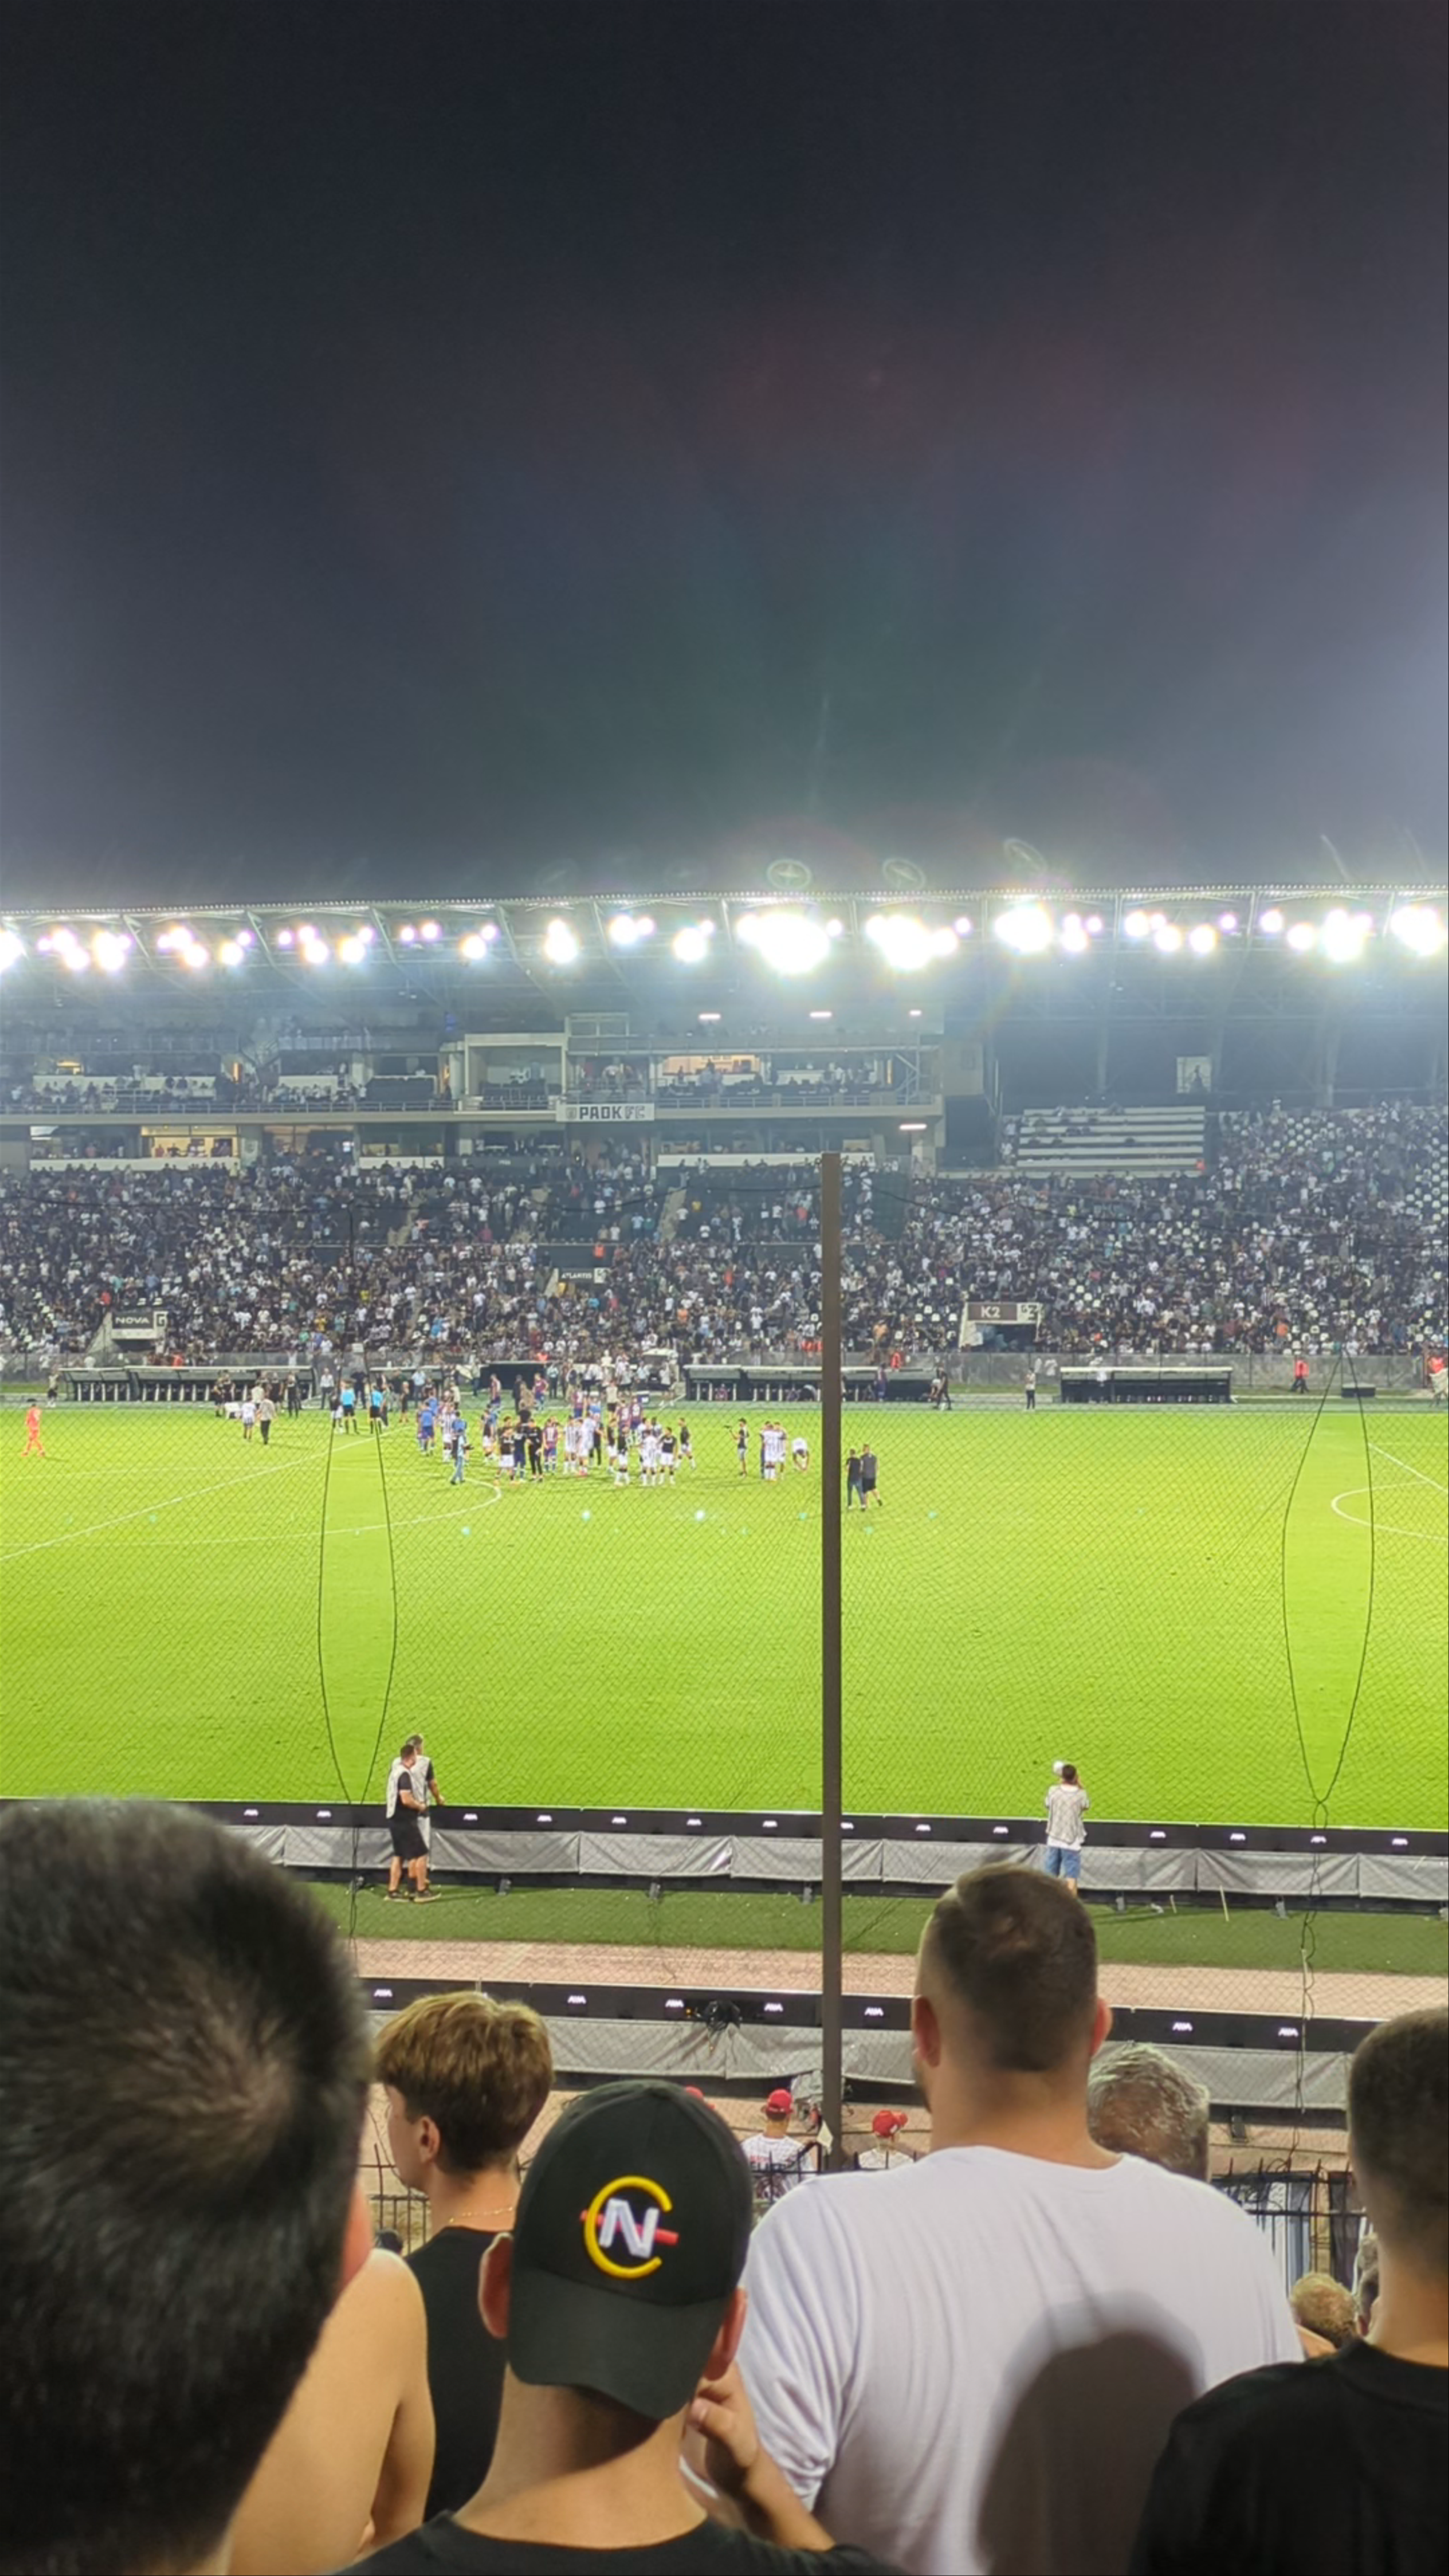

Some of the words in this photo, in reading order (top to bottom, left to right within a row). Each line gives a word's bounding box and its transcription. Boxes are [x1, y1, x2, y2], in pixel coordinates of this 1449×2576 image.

[580, 1106, 622, 1120] PAOK
[625, 1105, 645, 1120] FC
[981, 1306, 1000, 1318] K2
